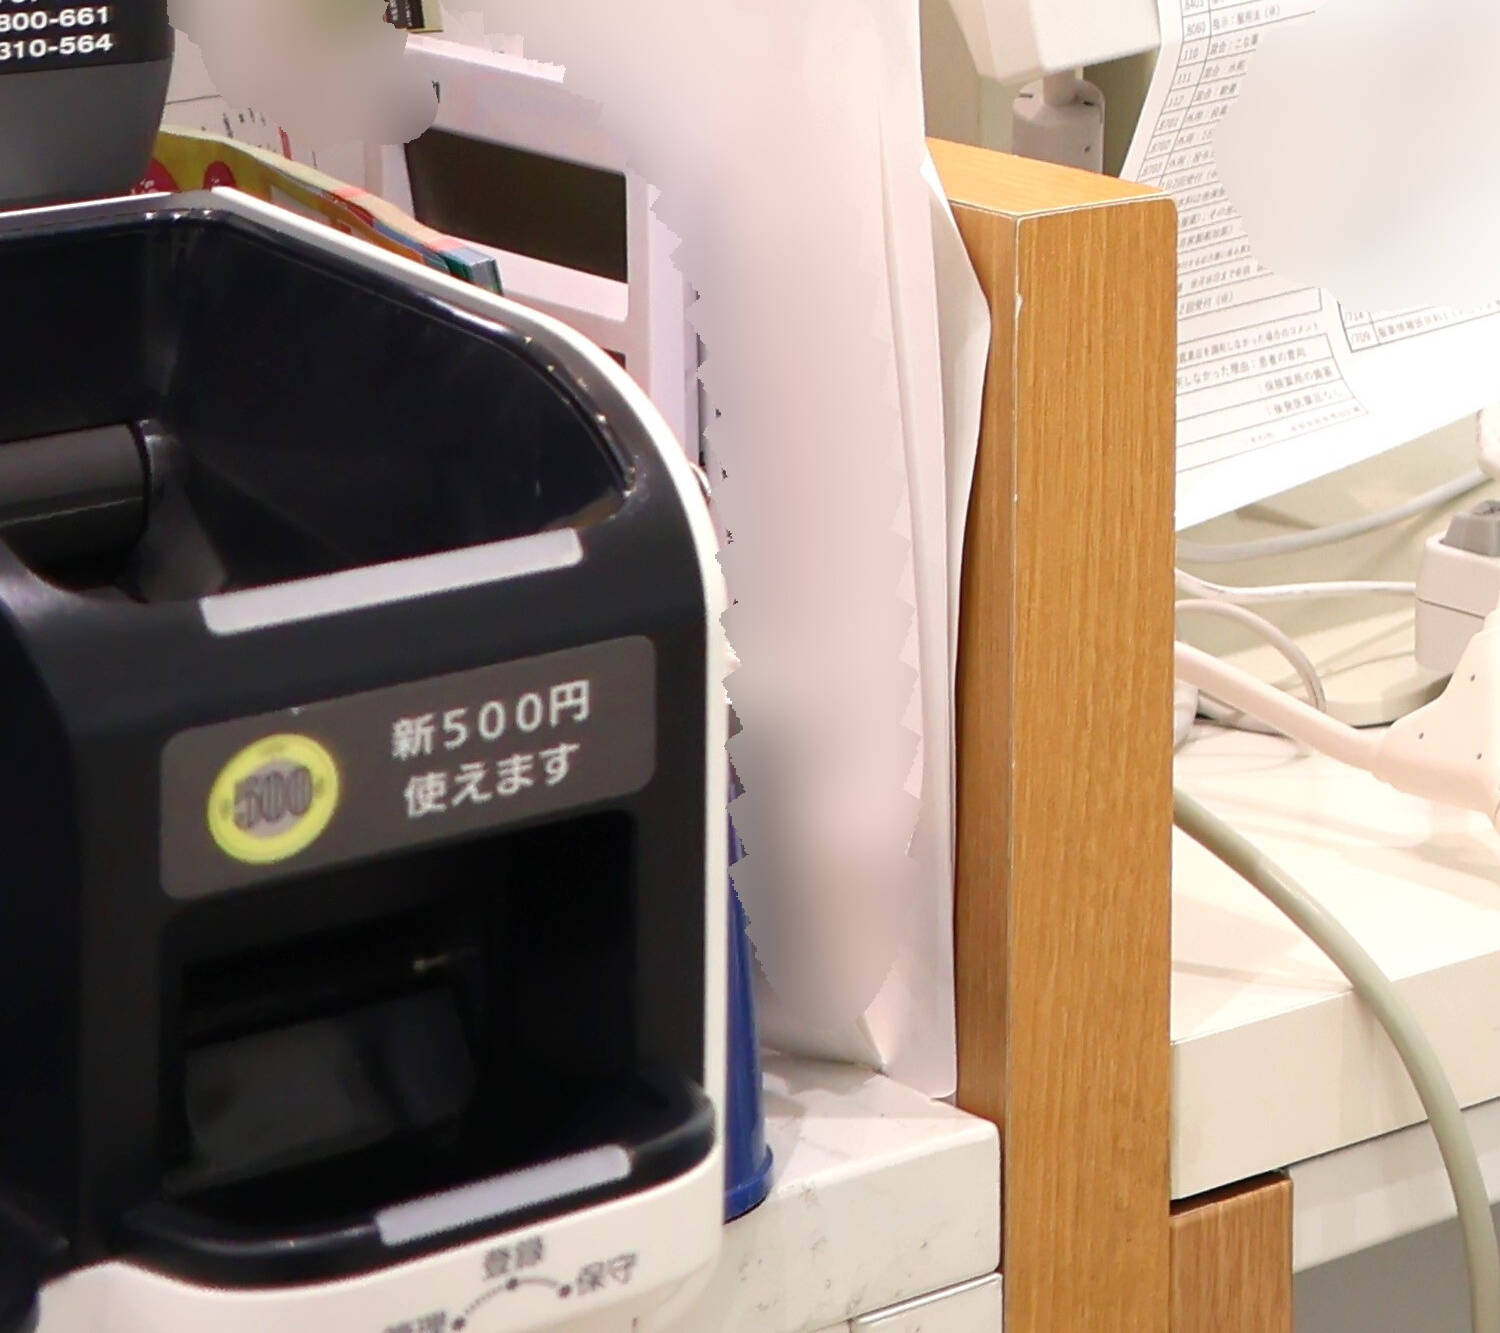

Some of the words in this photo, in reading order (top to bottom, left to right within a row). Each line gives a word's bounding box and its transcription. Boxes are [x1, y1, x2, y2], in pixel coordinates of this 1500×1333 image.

[391, 679, 592, 762] 新500円
[404, 742, 582, 820] 使えます
